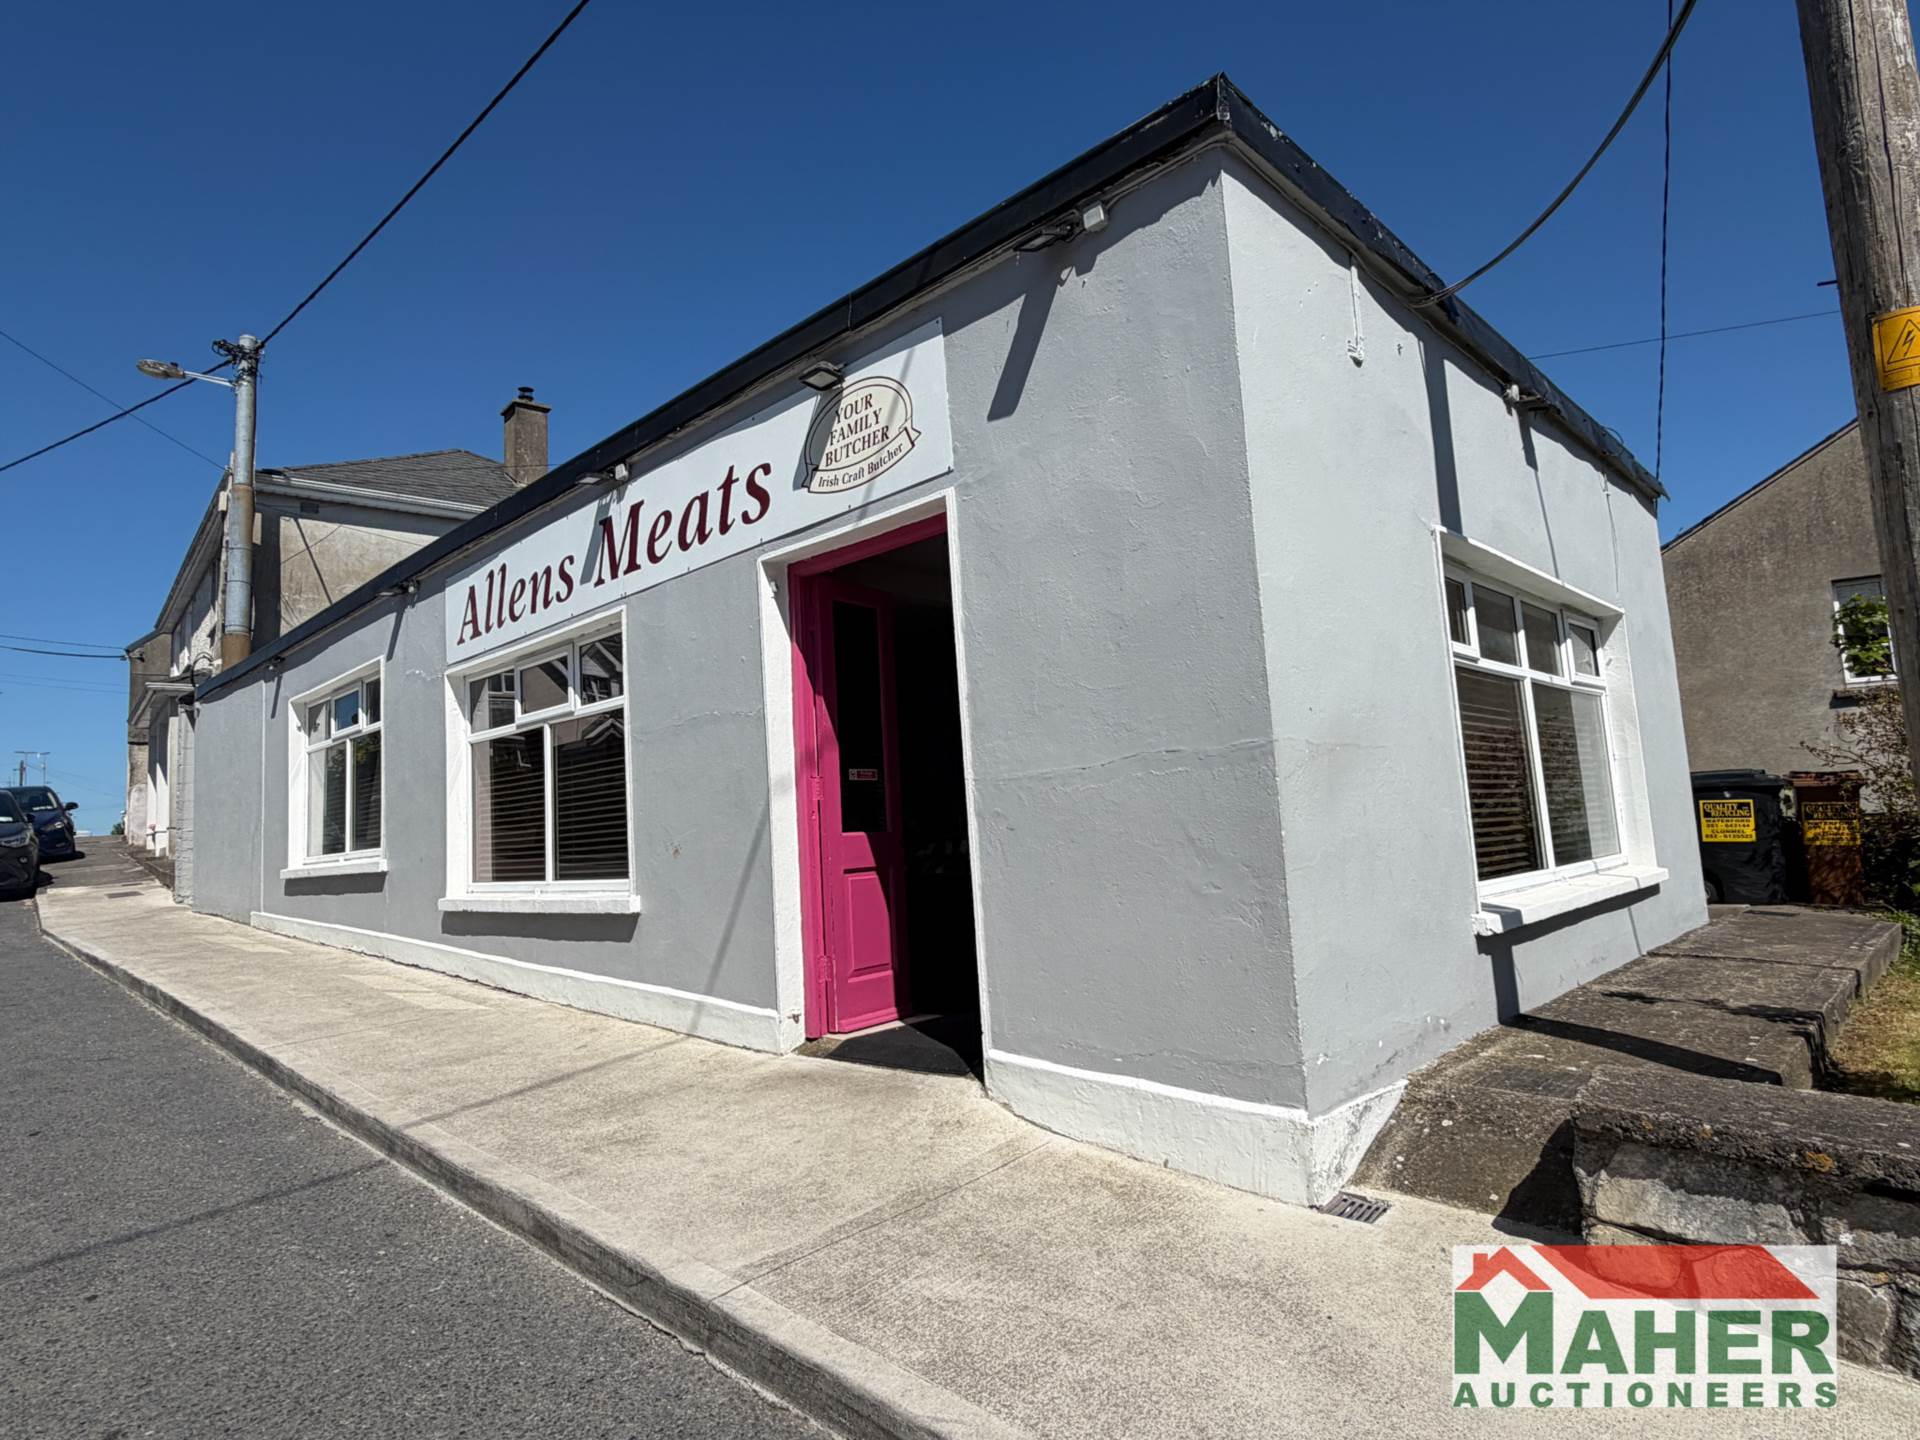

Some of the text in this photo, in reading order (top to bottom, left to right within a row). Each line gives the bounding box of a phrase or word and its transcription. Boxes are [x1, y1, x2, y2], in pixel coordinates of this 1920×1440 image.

[829, 408, 882, 446] FAMILY
[835, 393, 873, 425] YOUR
[818, 443, 903, 487] Irish Craft Butcher
[825, 425, 890, 467] BUTCHER
[457, 462, 772, 646] Allens Meats
[1703, 803, 1738, 812] QUALITY
